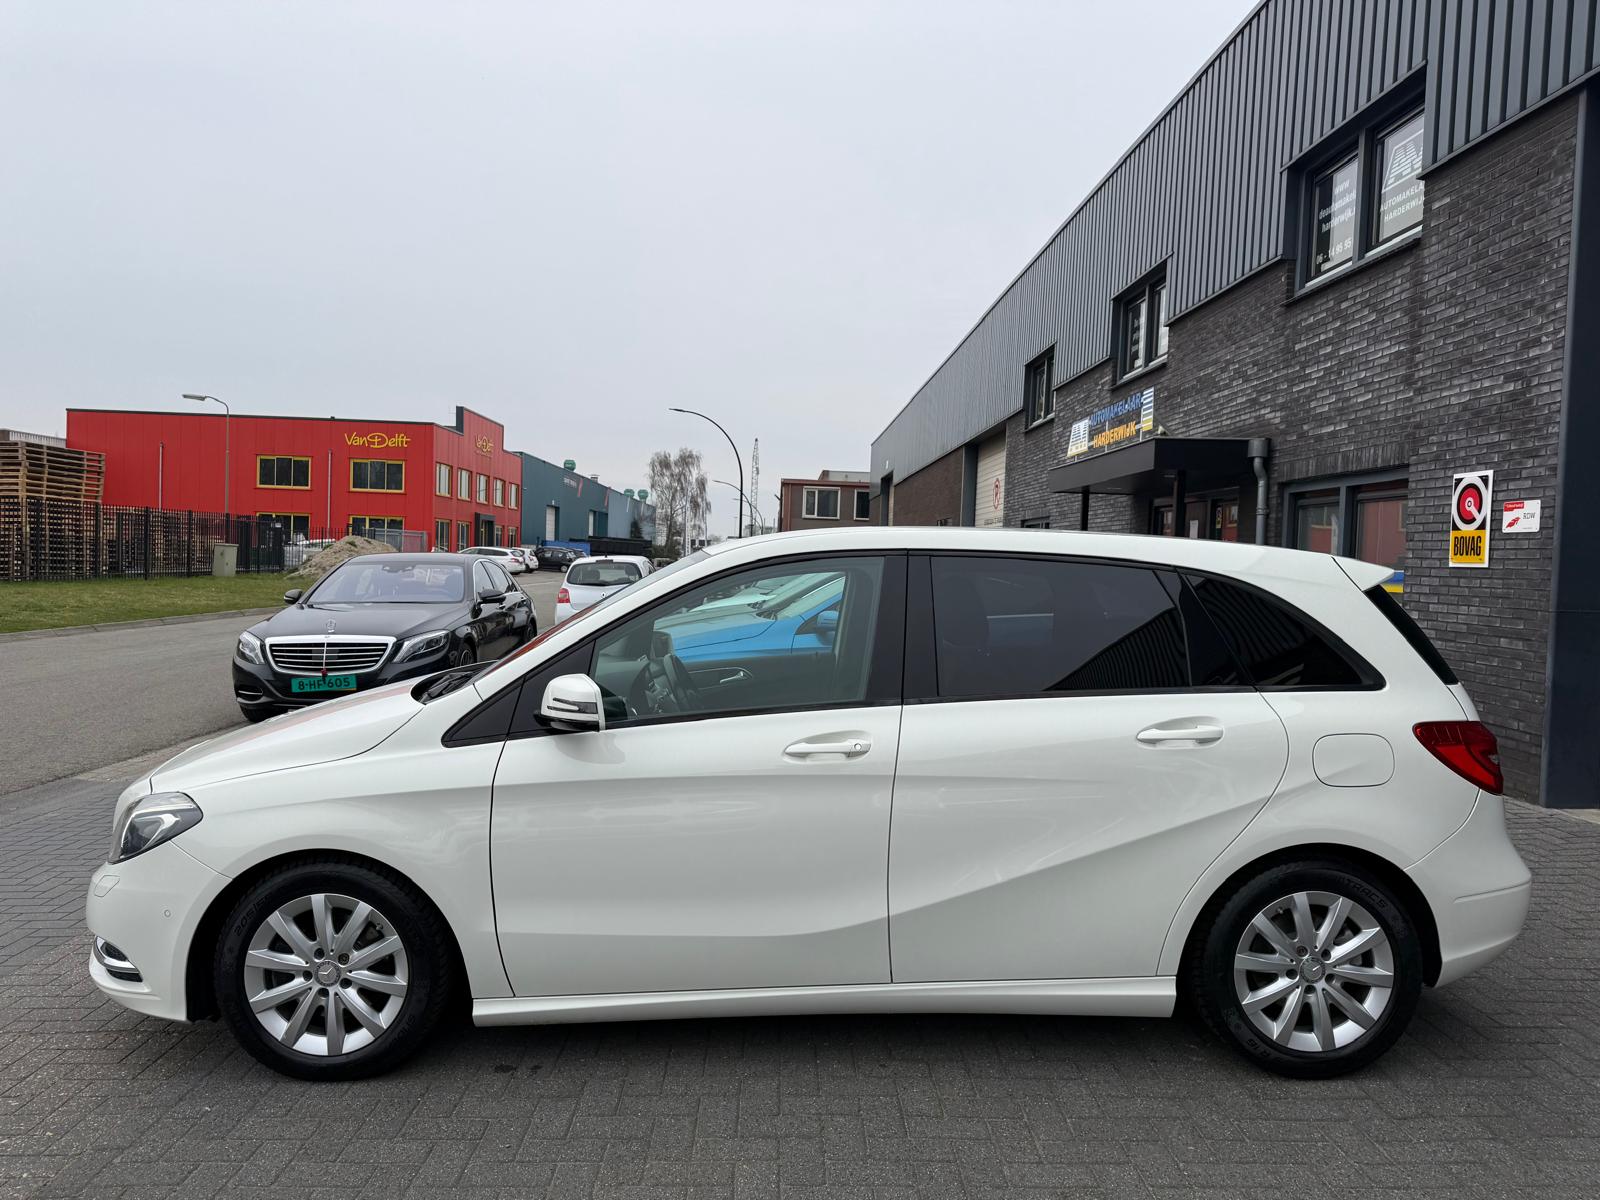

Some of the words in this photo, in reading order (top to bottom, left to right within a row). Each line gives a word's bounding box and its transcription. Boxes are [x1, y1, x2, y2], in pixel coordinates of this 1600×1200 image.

[1089, 393, 1141, 427] AUTOMAKELAAR
[1093, 421, 1136, 448] HARDERWIJK
[1453, 535, 1482, 557] BOVAG
